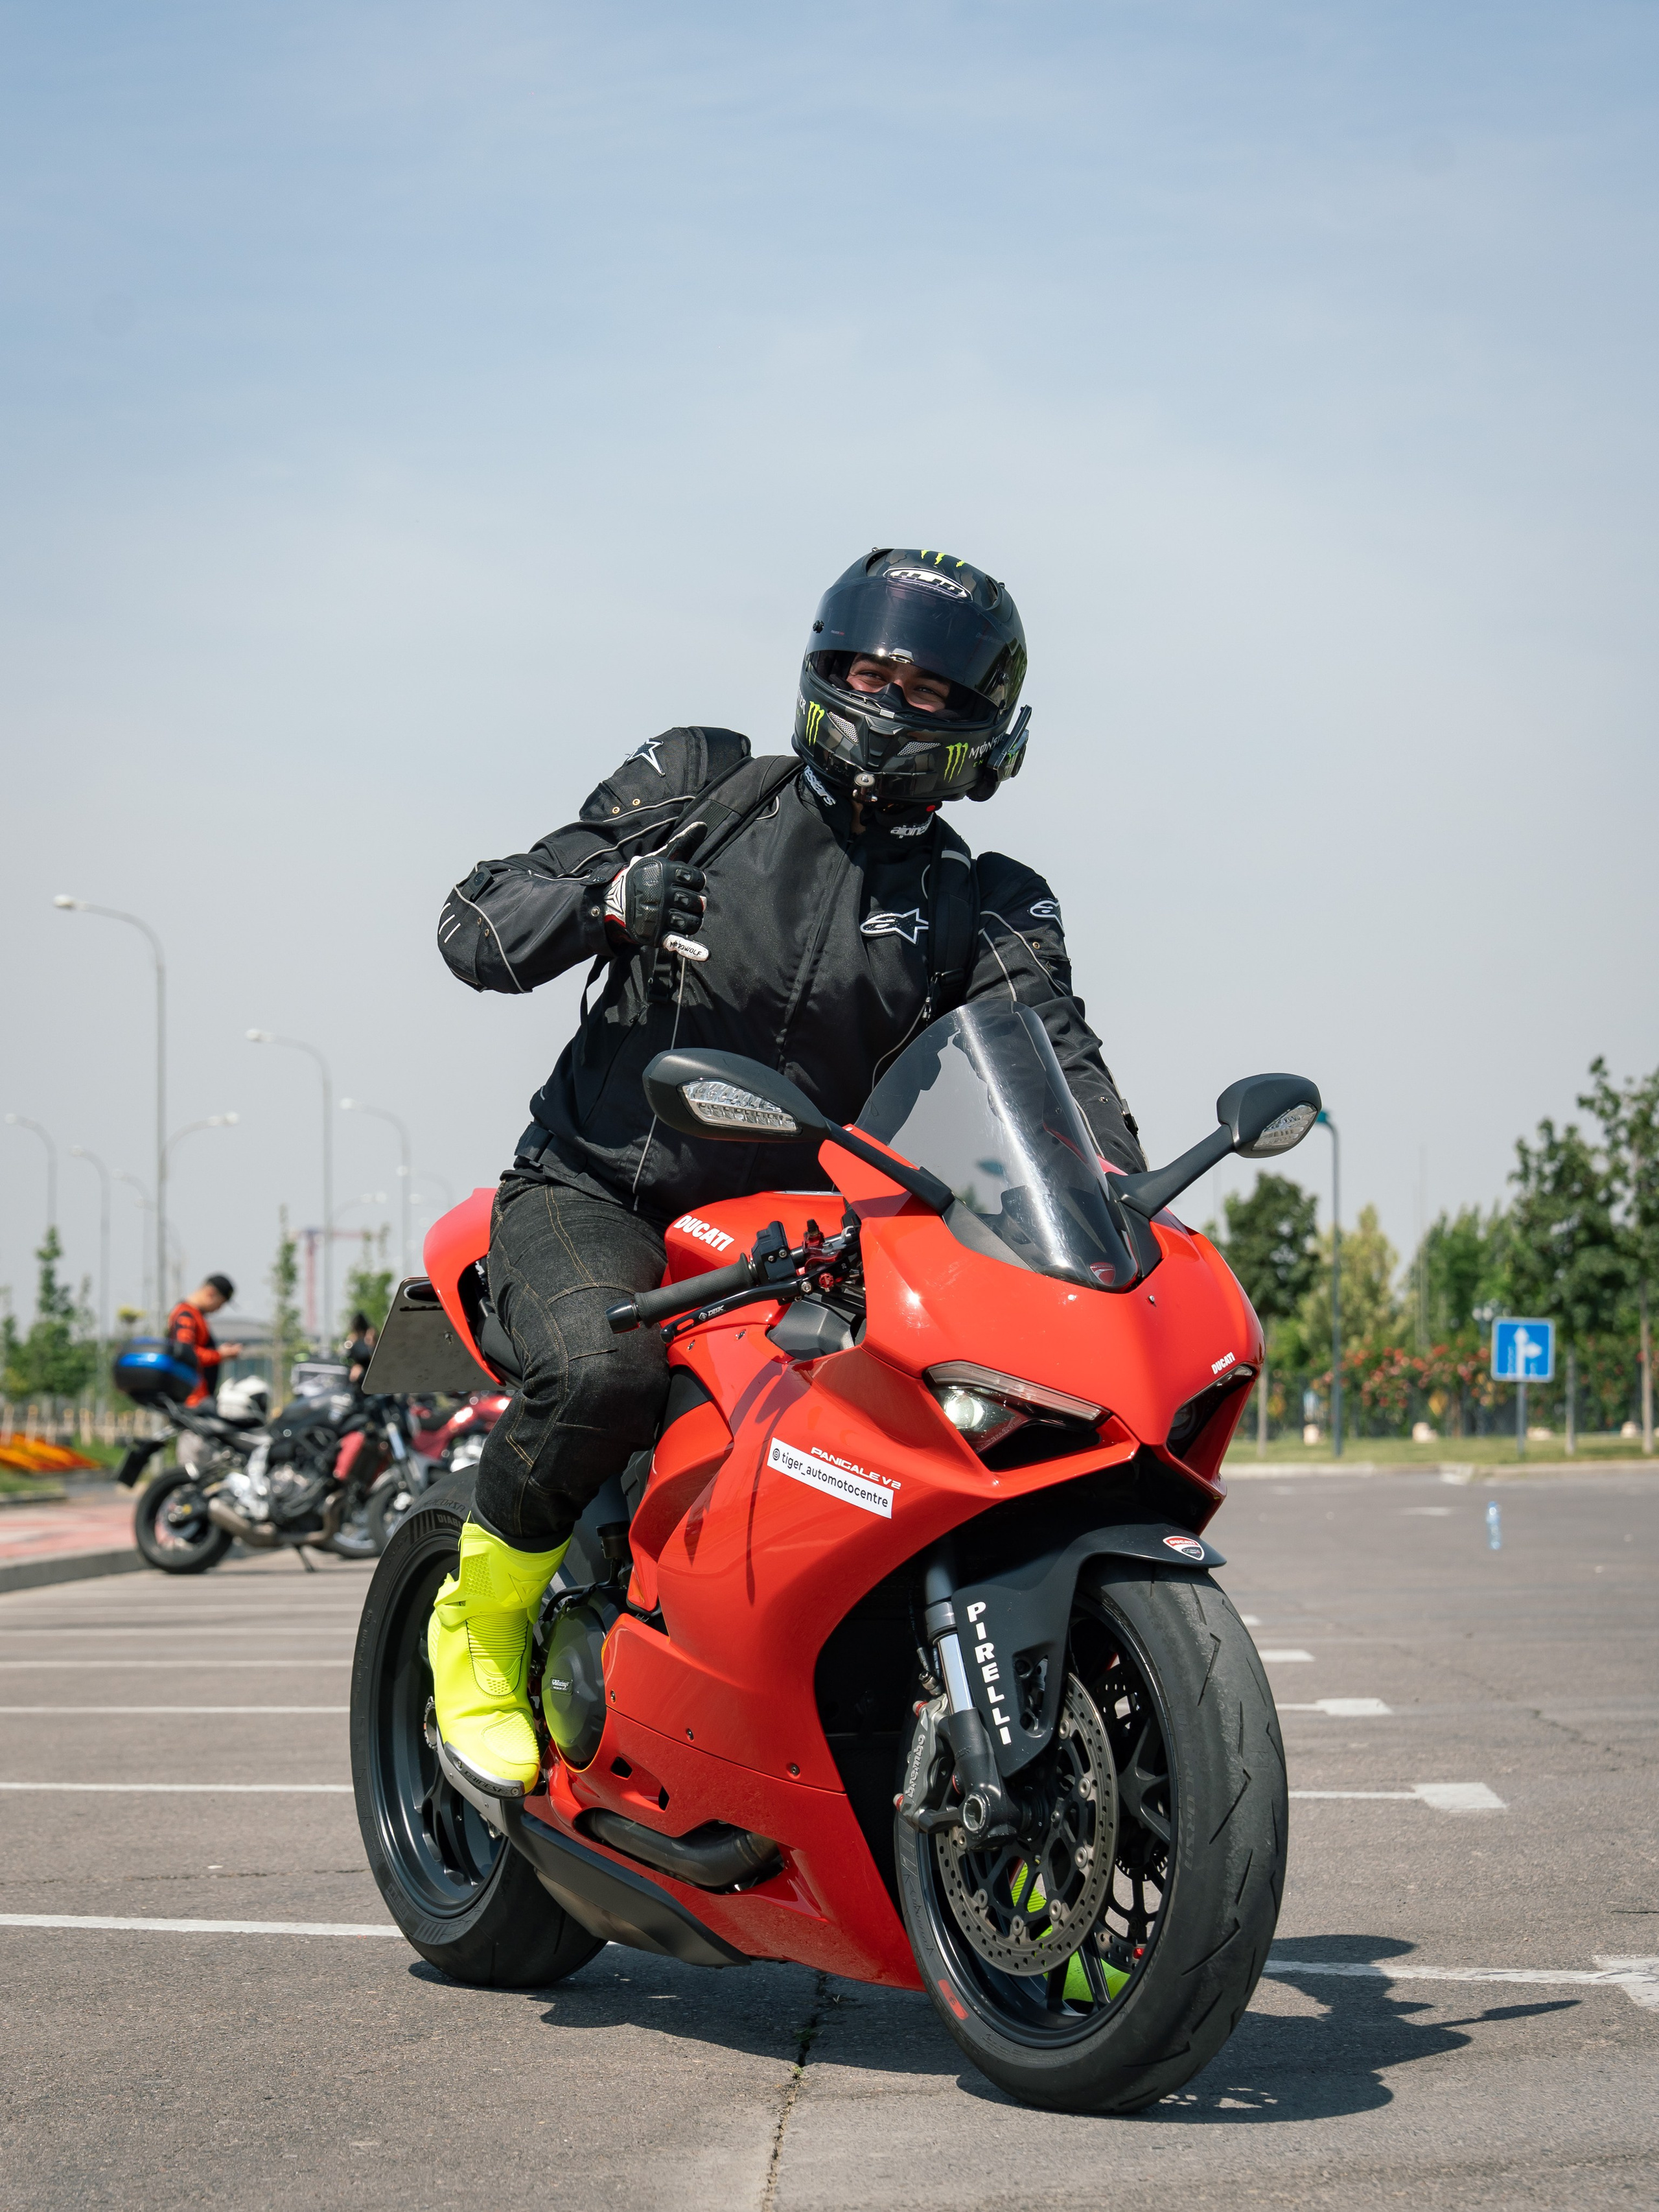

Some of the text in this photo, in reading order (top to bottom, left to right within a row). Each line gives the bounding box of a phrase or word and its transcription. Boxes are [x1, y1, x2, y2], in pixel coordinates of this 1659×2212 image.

[673, 1214, 736, 1252] DUCATI
[1211, 1351, 1236, 1375] DUCATI
[782, 1452, 888, 1508] tiger_automotocentre
[811, 1447, 902, 1489] PANIGALE V2
[967, 1601, 1012, 1745] PIRELLI
[905, 1734, 926, 1799] brembo
